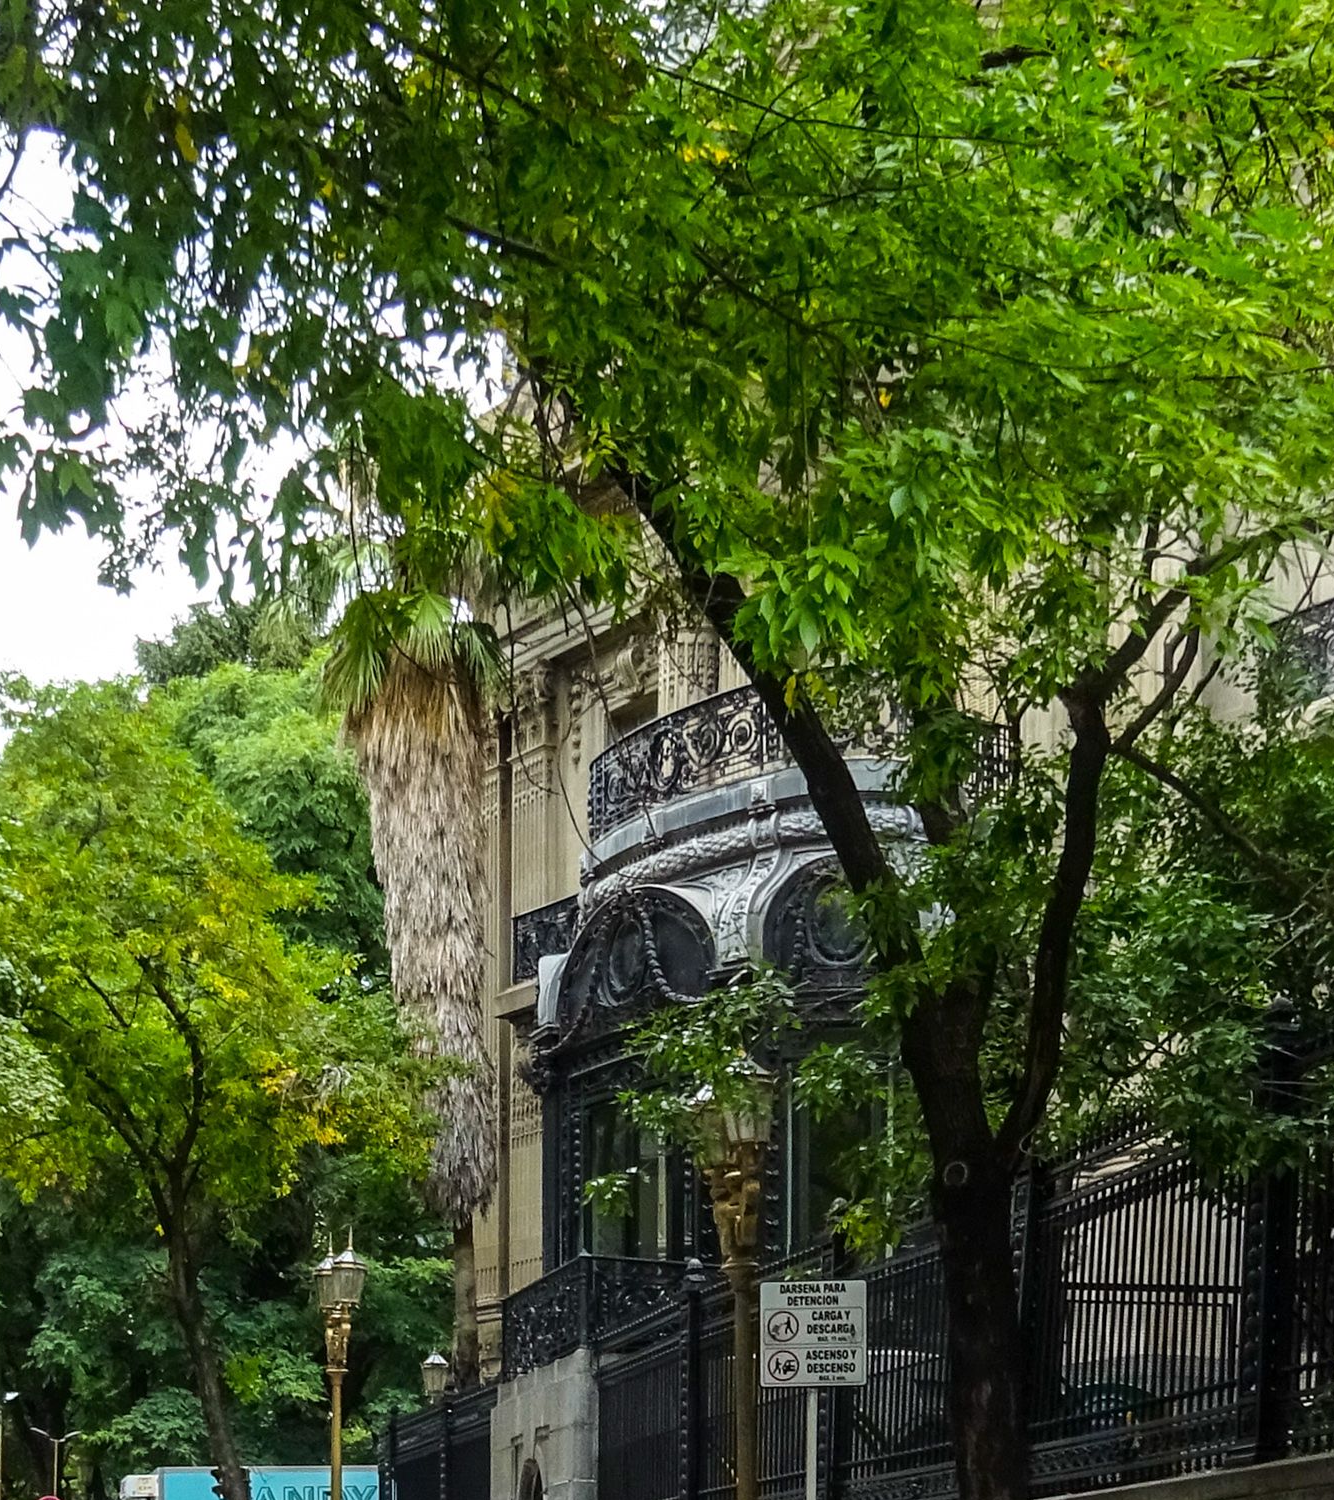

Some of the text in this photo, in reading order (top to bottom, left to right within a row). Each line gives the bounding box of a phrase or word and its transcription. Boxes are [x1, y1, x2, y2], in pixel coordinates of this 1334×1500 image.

[779, 1282, 846, 1294] DARSENA PARA
[787, 1295, 839, 1306] DETENCION
[811, 1310, 851, 1321] CARGA Y
[807, 1323, 855, 1334] DESCARGA
[806, 1349, 857, 1361] ASCENSO Y
[807, 1362, 856, 1373] DESCENSO
